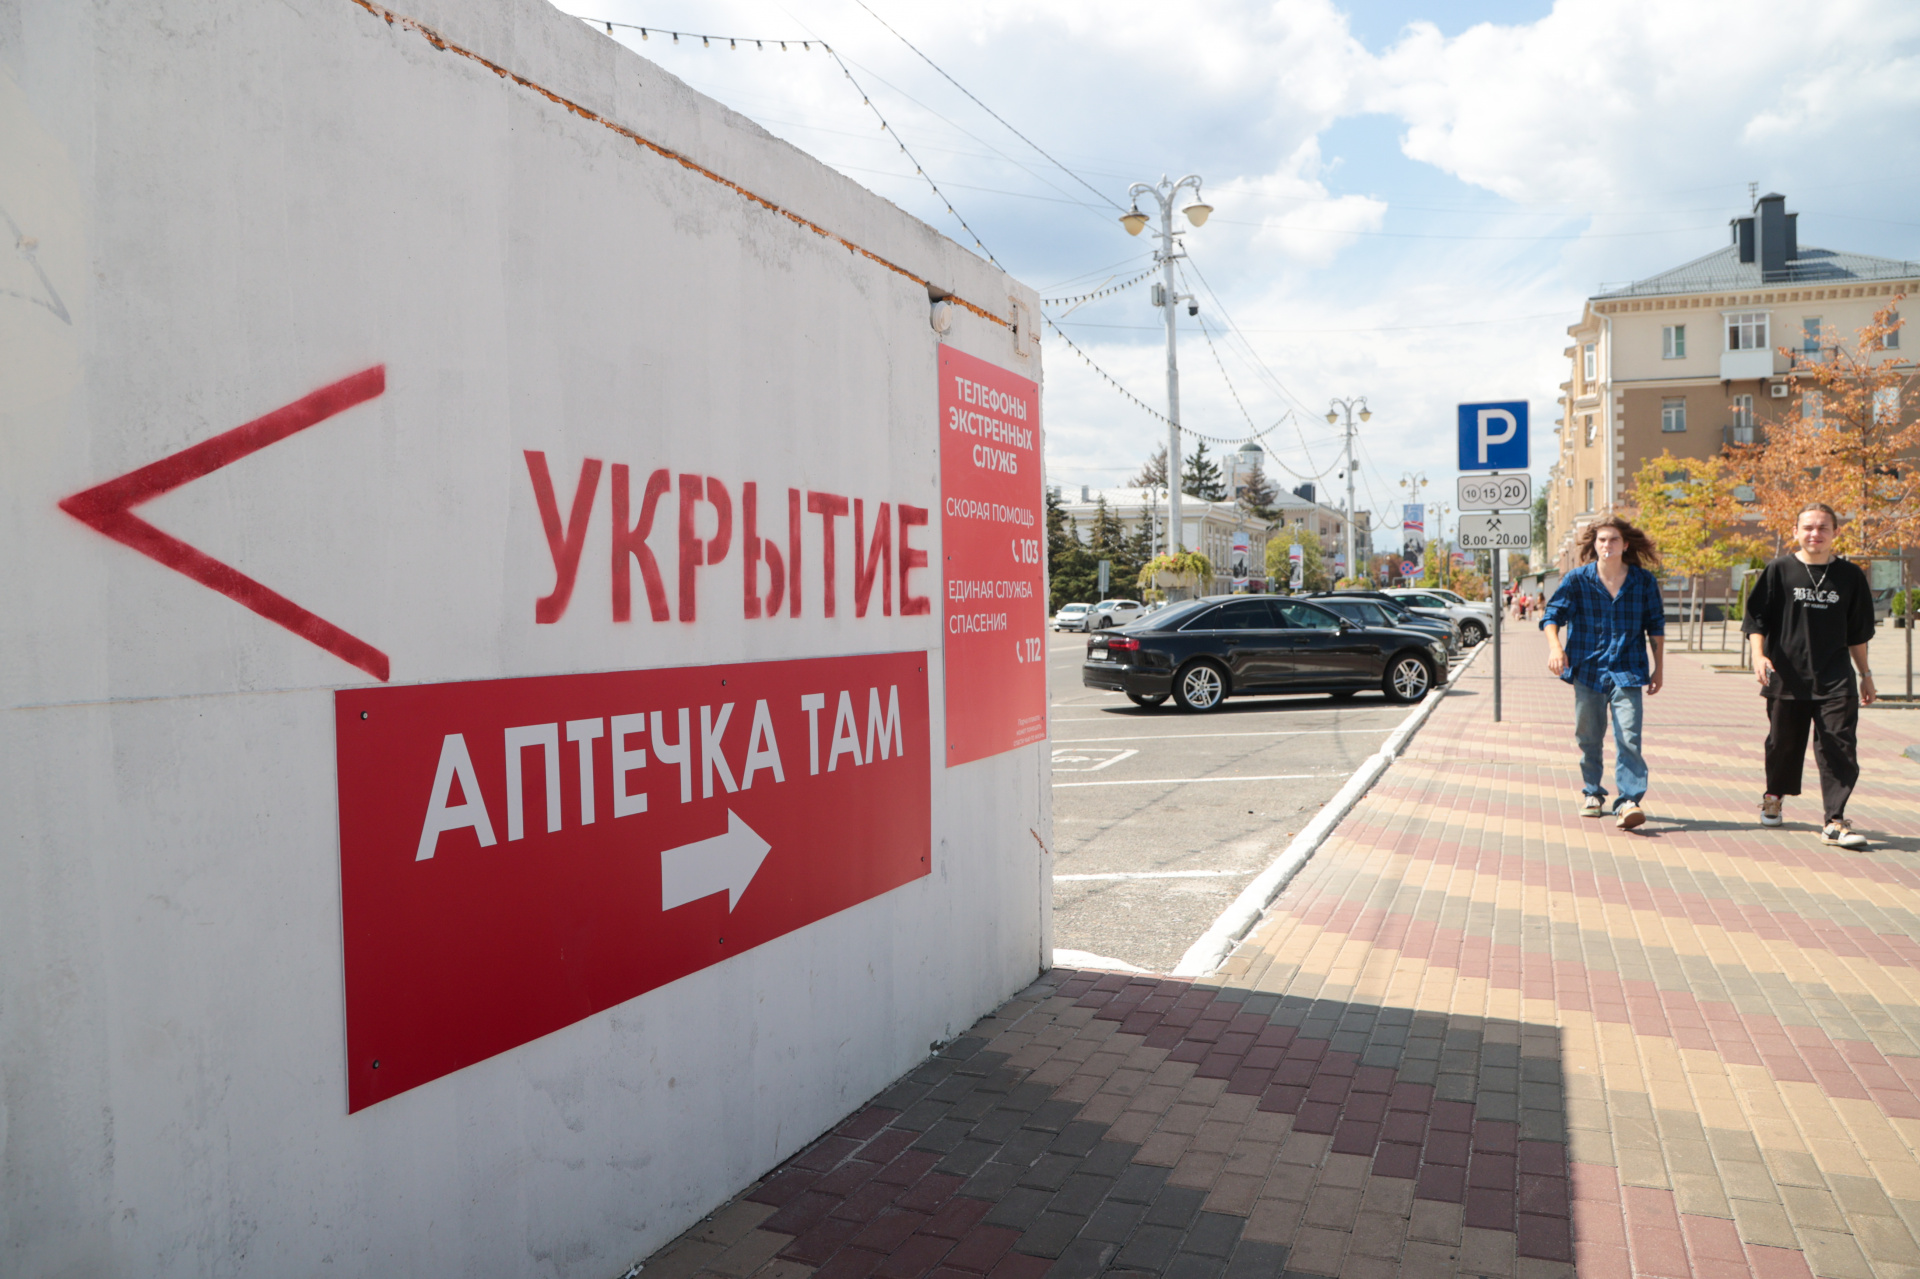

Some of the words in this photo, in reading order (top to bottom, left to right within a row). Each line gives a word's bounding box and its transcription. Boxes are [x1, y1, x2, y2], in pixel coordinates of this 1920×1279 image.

[955, 376, 1027, 421] ТЕЛЕФОНЫ
[949, 406, 1033, 451] ЭКСТРЕННЫХ
[1478, 409, 1517, 463] P
[973, 444, 1018, 475] СЛУЖБ
[1466, 489, 1477, 499] 10
[1483, 488, 1496, 499] 15
[1504, 485, 1520, 498] 20
[946, 497, 990, 521] СКОРАЯ
[992, 504, 1035, 529] ПОМОЩЬ
[522, 449, 931, 624] УКРЫТИЕ
[1020, 538, 1039, 565] 103
[949, 580, 994, 603] ЕДИНАЯ
[995, 581, 1033, 599] СЛУЖБА
[949, 613, 1007, 634] СПАСЕНИЯ
[1025, 637, 1041, 663] 112
[415, 698, 785, 862] АПТЕЧКА
[801, 684, 903, 777] ТАМ
